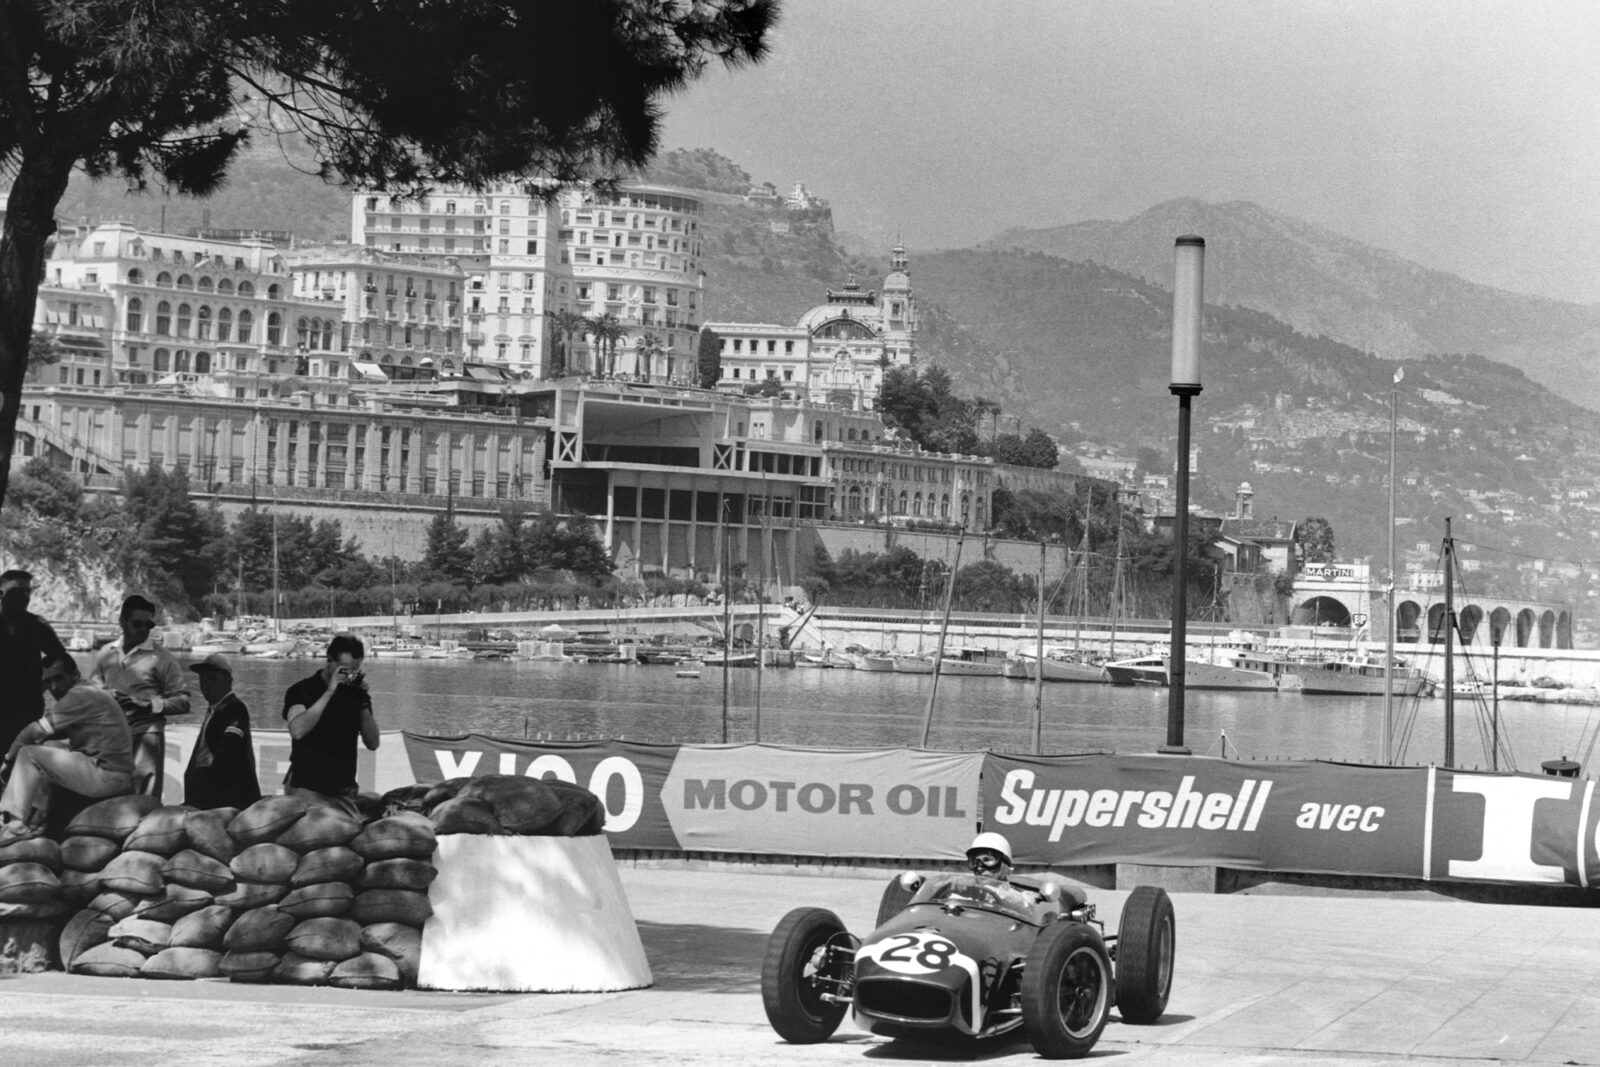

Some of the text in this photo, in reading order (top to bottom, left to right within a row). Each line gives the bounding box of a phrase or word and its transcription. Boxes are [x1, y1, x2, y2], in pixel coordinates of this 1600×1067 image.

[1307, 568, 1354, 577] MARTINI
[1354, 614, 1367, 625] BP
[683, 779, 875, 815] MOTOR
[886, 784, 966, 818] OIL
[994, 769, 1385, 842] Supershell avec
[879, 935, 957, 970] 28
